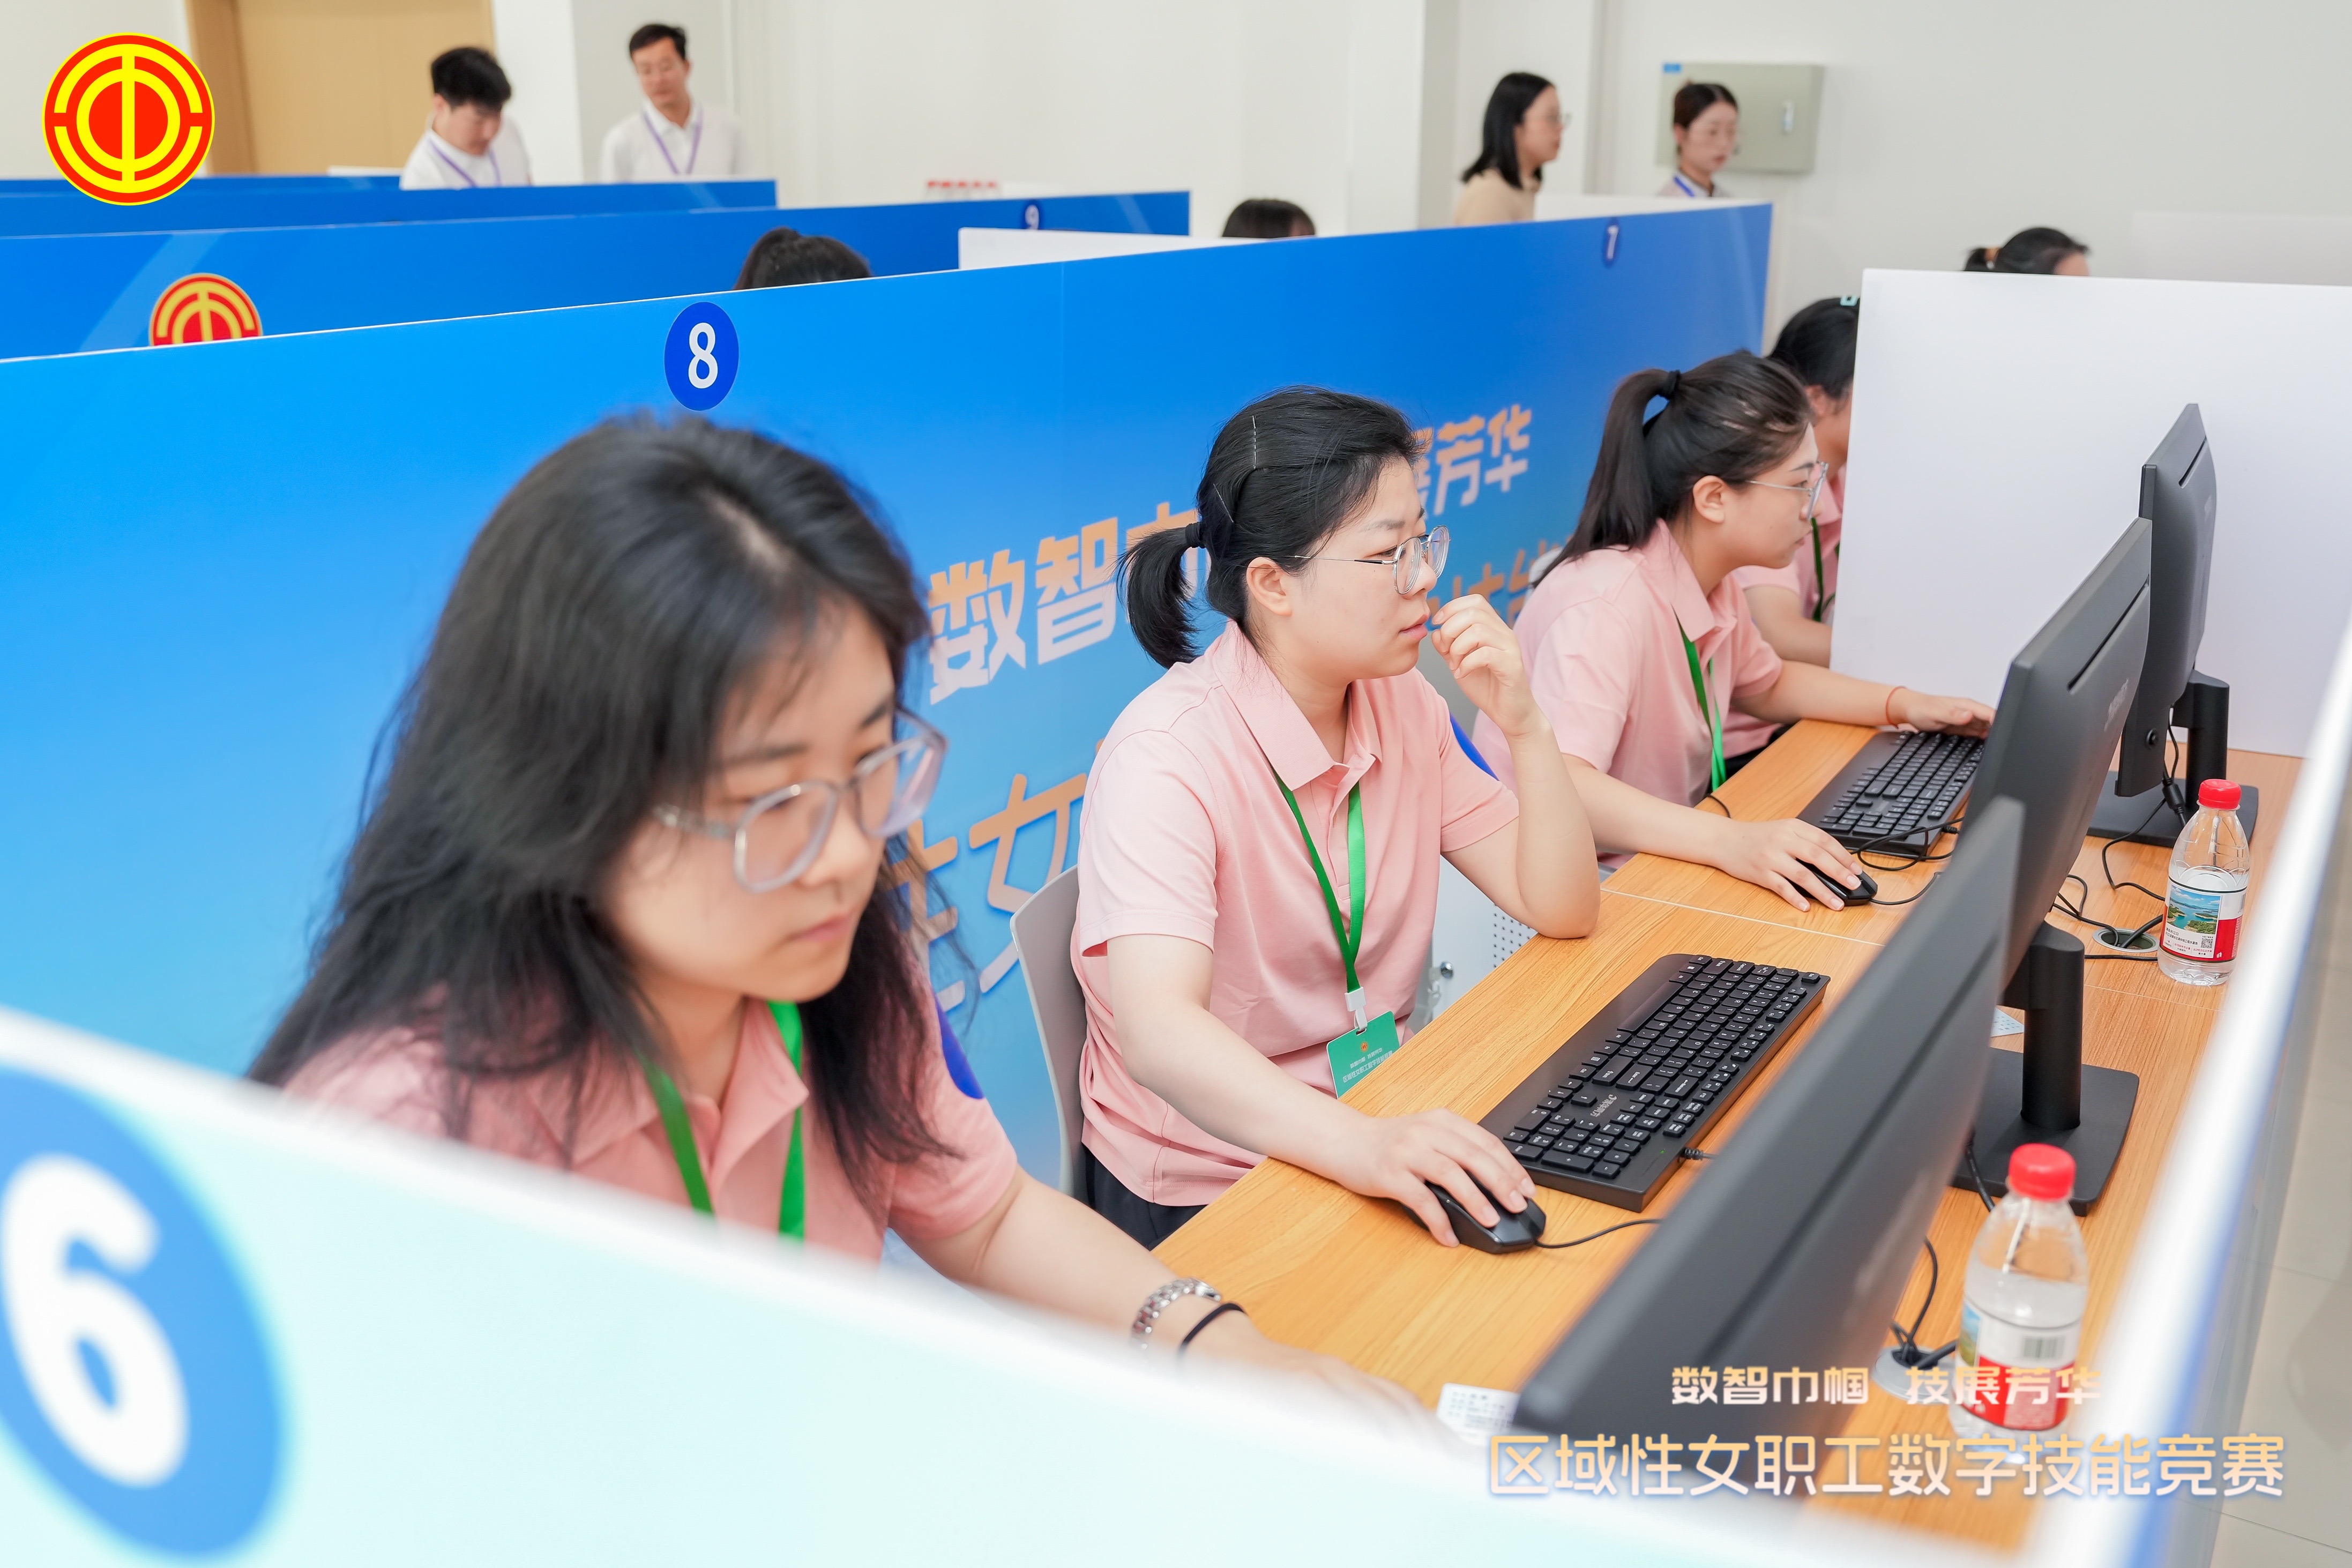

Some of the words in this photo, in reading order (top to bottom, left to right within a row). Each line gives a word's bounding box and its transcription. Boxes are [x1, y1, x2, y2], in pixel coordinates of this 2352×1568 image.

[1025, 204, 1040, 230] 9
[688, 322, 719, 389] 8
[1590, 1099, 1614, 1117] 清华同方
[2, 1155, 190, 1488] 6
